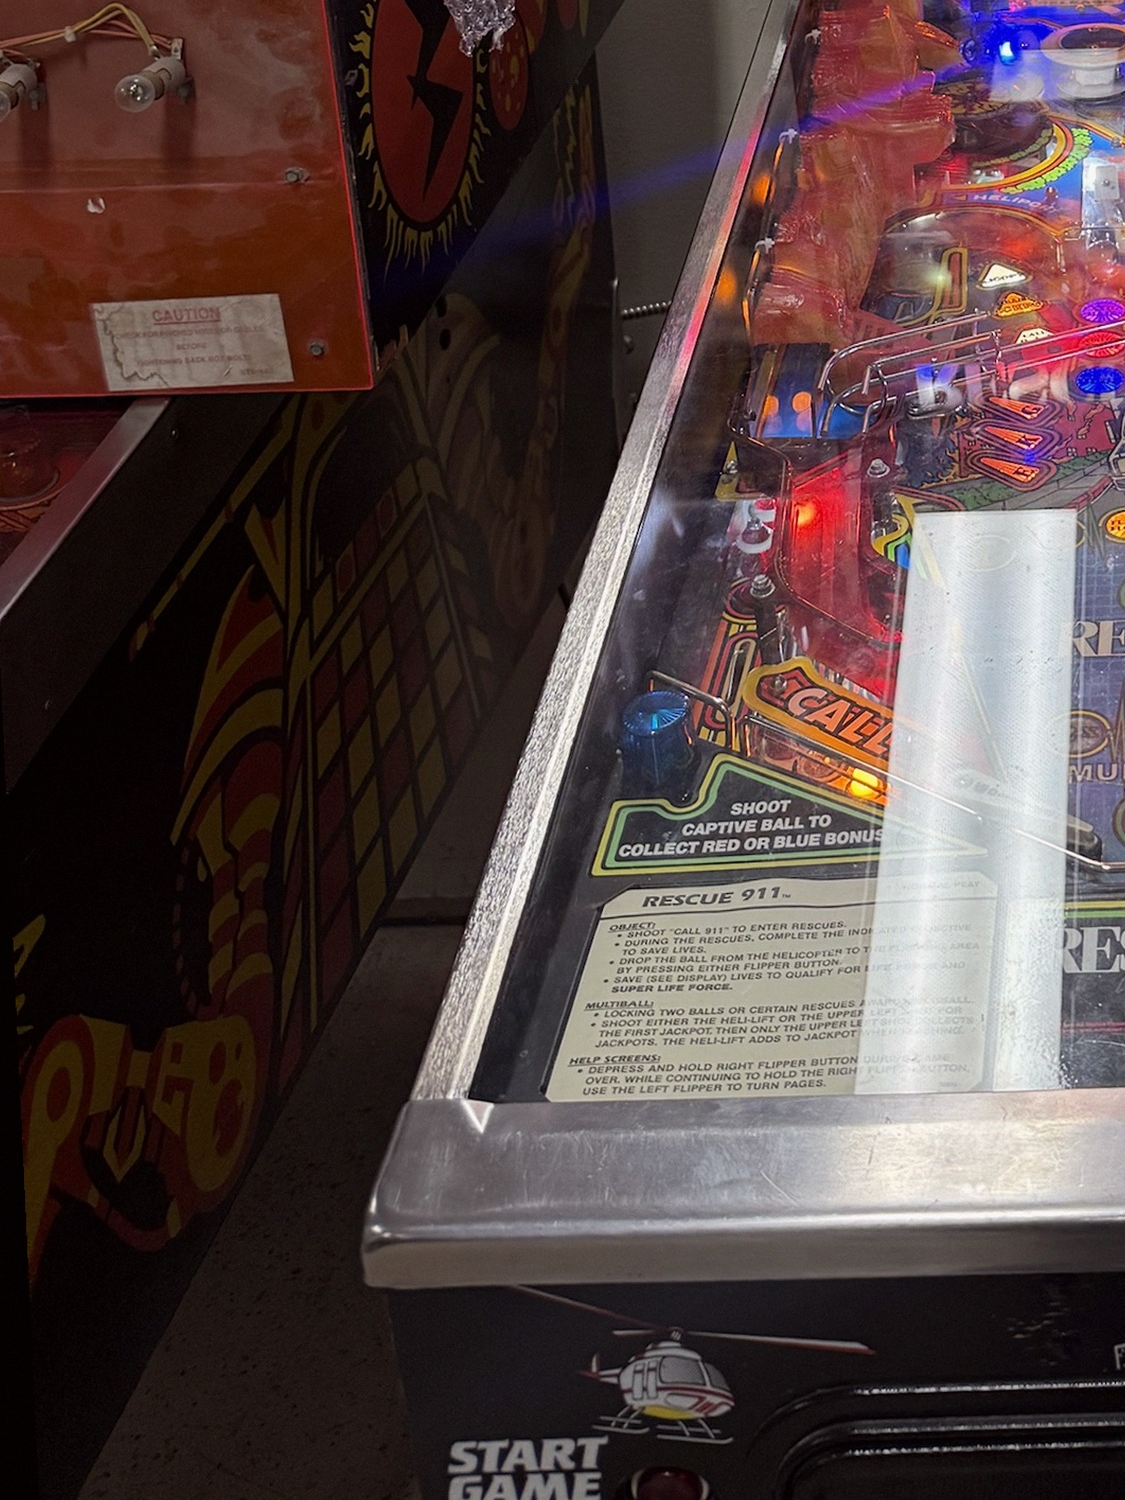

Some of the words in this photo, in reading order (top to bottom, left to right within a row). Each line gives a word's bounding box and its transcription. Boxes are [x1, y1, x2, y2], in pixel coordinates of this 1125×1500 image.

[152, 307, 221, 322] CAUTION
[787, 687, 895, 751] CALL
[730, 800, 791, 815] SHOOT
[682, 820, 757, 837] CAPTIVE
[761, 817, 804, 832] BALL
[809, 814, 832, 828] TO
[619, 841, 700, 858] COLLECT
[702, 838, 740, 852] RED
[744, 836, 770, 850] OR
[773, 833, 821, 849] BLUE
[825, 828, 884, 845] BONUS
[642, 891, 735, 907] RESCUE
[741, 887, 781, 900] 911
[608, 922, 656, 932] OBJECT:
[627, 929, 666, 938] SHOOT
[670, 927, 702, 936] "CALL
[705, 926, 730, 935] 911"
[733, 925, 746, 933] TO
[750, 922, 787, 932] ENTER
[792, 920, 847, 930] RESCUES.
[624, 937, 671, 947] DURING
[674, 936, 695, 945] THE
[758, 931, 818, 941] COMPLETE
[822, 929, 844, 938] THE
[619, 957, 651, 965] DROP
[654, 956, 676, 964] THE
[679, 954, 708, 964] BALL
[711, 953, 744, 962] FROM
[747, 952, 769, 960] THE
[772, 949, 842, 960] HELICOPTER
[846, 947, 861, 955] TO
[622, 948, 636, 956] TO
[640, 947, 669, 955] SAVE
[672, 946, 707, 954] LIVES.
[614, 976, 644, 984] SAVE
[646, 975, 674, 983] (SEE
[677, 973, 727, 983] DISPLAY)
[731, 972, 762, 981] LIVES
[767, 971, 782, 979] TO
[785, 968, 833, 979] QUALIFY
[837, 965, 861, 975] FOR
[617, 966, 632, 974] BY
[637, 964, 700, 974] PRESSING
[703, 963, 740, 972] EITHER
[744, 961, 790, 971] FLIPPER
[794, 959, 842, 969] BUTTON.
[611, 985, 654, 993] SUPER
[657, 984, 684, 992] LIFE
[688, 983, 733, 991] FORCE.
[584, 1001, 654, 1010] MULTIBALL:
[604, 1009, 657, 1018] LOCKING
[660, 1008, 685, 1016] TWO
[689, 1007, 725, 1015] BALLS
[728, 1006, 746, 1014] OR
[749, 1004, 797, 1014] CERTAIN
[801, 1001, 855, 1012] RESCUES
[568, 1055, 601, 1065] HELP
[603, 1054, 661, 1064] SCREENS:
[448, 1435, 609, 1473] START
[448, 1472, 602, 1500] GAME
